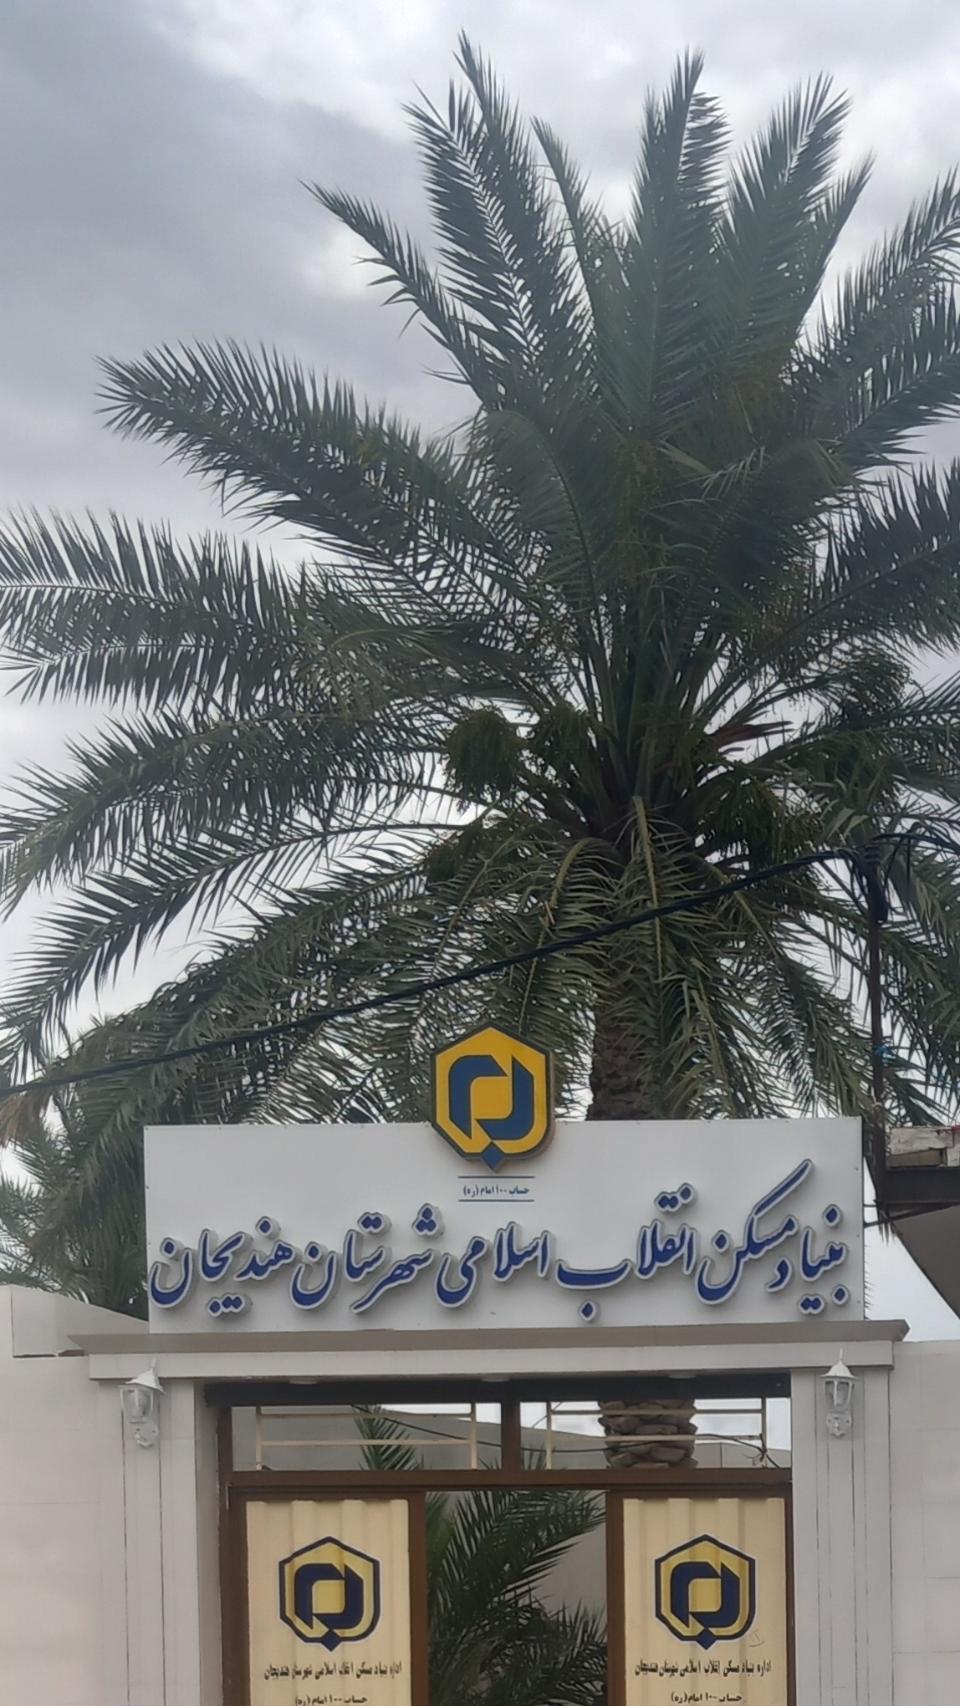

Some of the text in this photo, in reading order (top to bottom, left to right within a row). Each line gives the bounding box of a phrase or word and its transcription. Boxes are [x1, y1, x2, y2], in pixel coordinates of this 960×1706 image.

[509, 1184, 530, 1194] حساب
[149, 1159, 849, 1322] بنیاد مسکن انقلاب اسلامی شهرستان هندیجان
